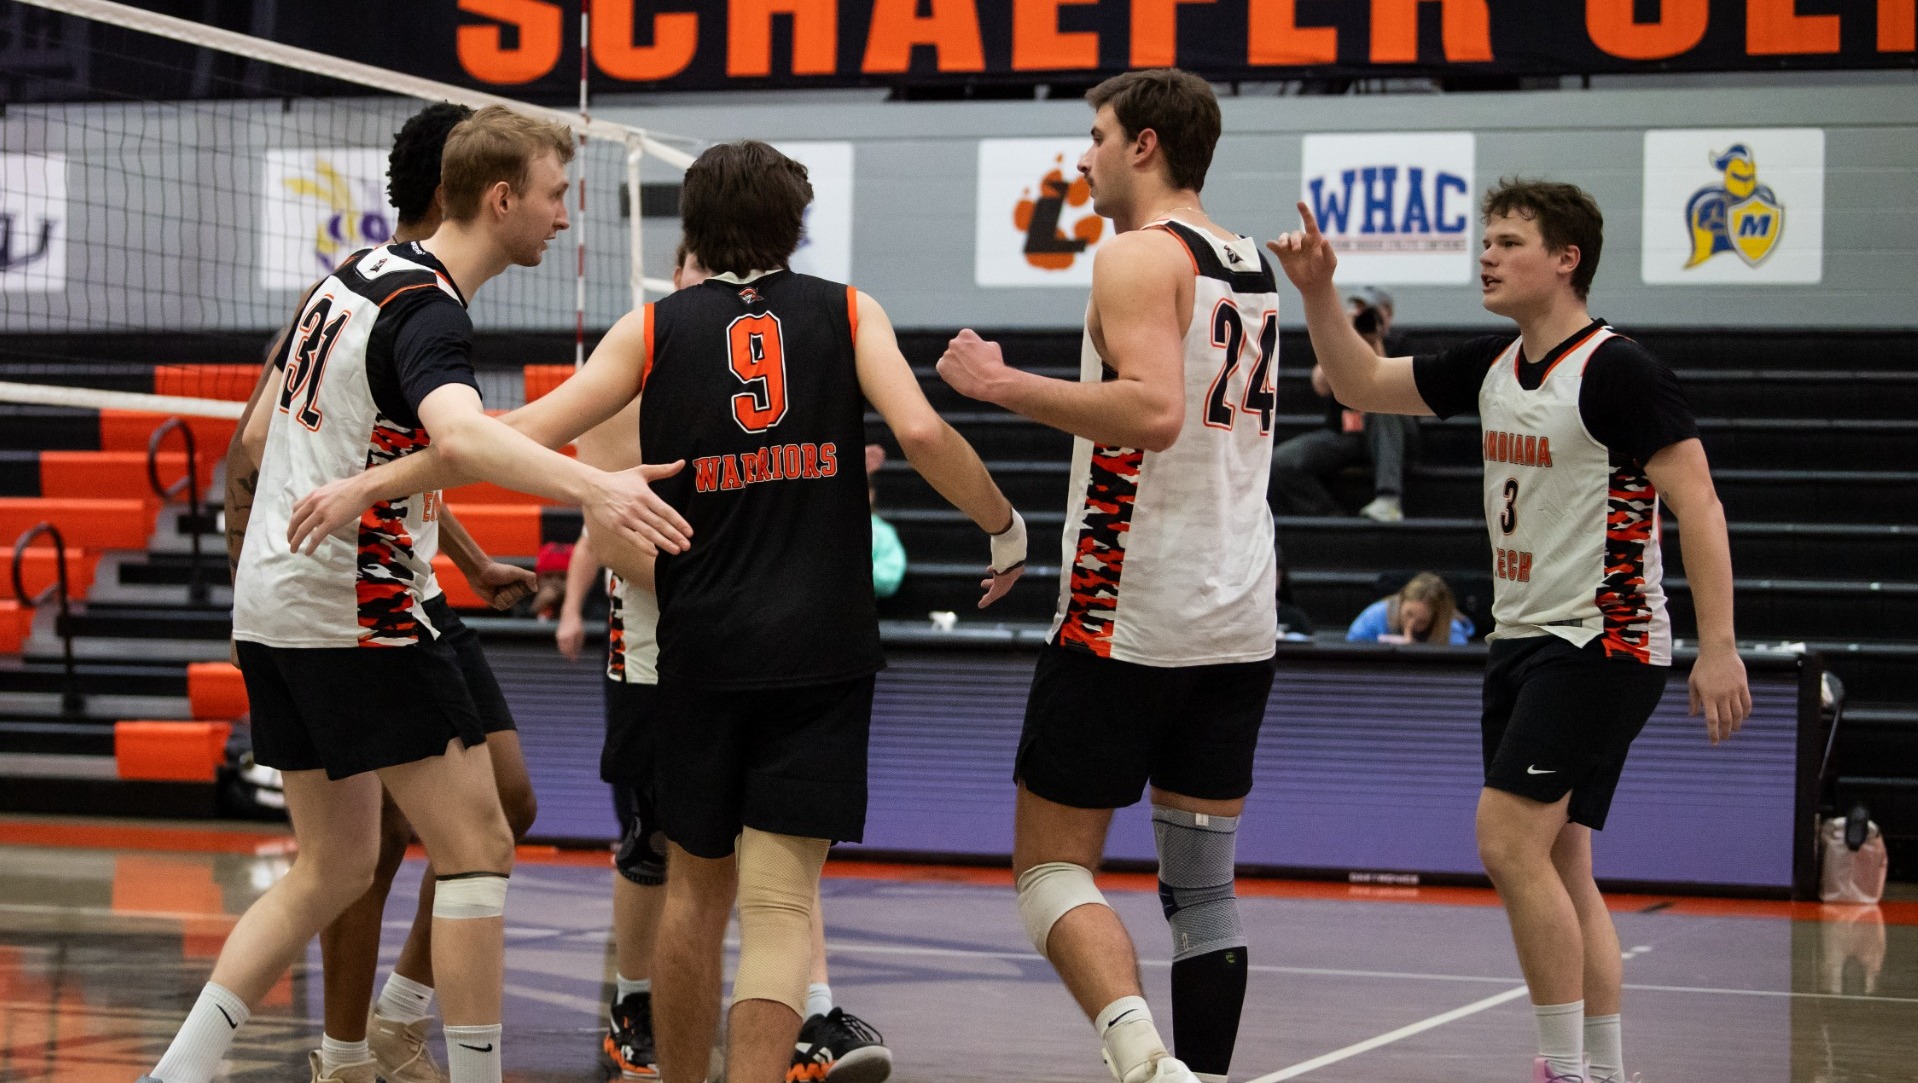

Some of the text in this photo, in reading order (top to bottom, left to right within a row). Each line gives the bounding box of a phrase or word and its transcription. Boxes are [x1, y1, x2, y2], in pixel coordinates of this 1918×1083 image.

[1309, 165, 1467, 233] WHAC
[1739, 213, 1772, 237] M
[279, 293, 352, 432] 31
[726, 310, 788, 434] 9
[1203, 297, 1278, 437] 24
[692, 442, 838, 493] WARRIORS
[1483, 430, 1553, 468] INDIANA
[1501, 477, 1519, 536] 3
[1496, 547, 1533, 582] ECH
